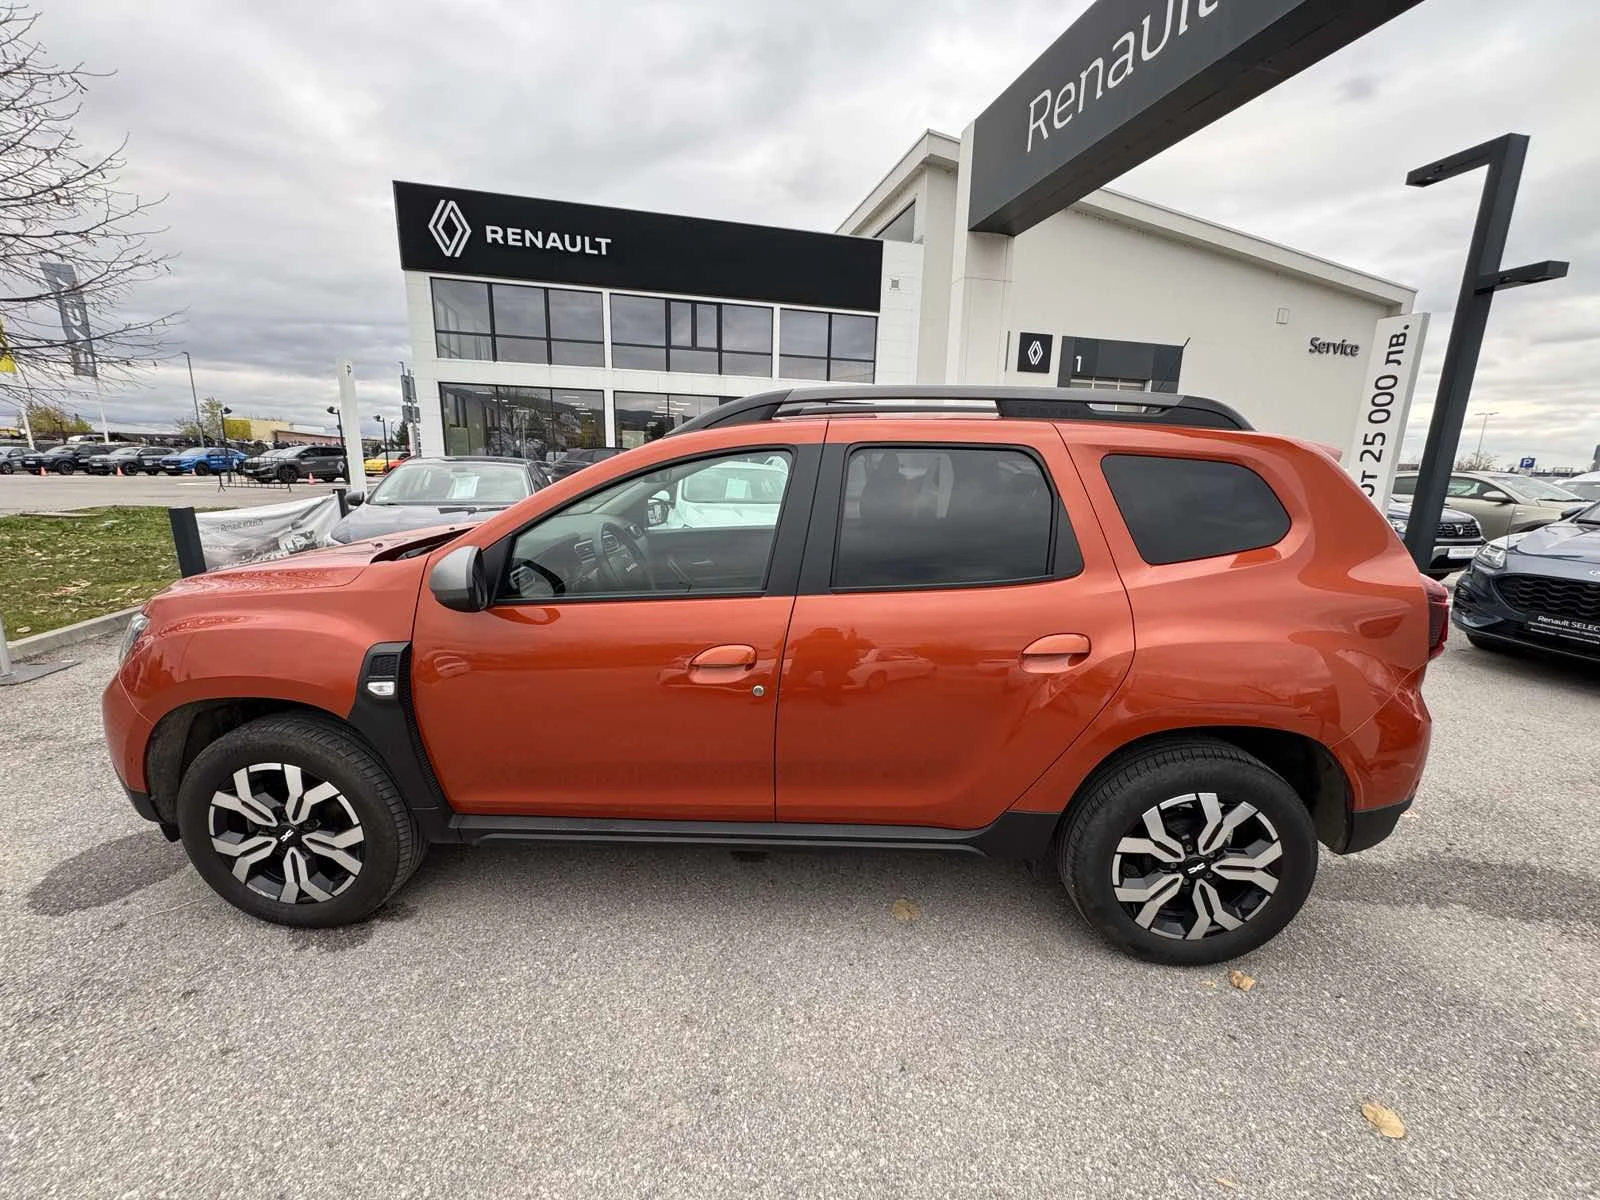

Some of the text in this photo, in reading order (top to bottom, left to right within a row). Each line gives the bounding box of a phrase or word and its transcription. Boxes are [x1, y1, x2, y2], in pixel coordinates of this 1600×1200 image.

[485, 224, 612, 255] RENAULT
[1308, 336, 1360, 357] Service
[1075, 355, 1082, 372] 1
[1368, 374, 1399, 424] 000
[1359, 431, 1386, 463] 25
[1537, 615, 1570, 627] Renault
